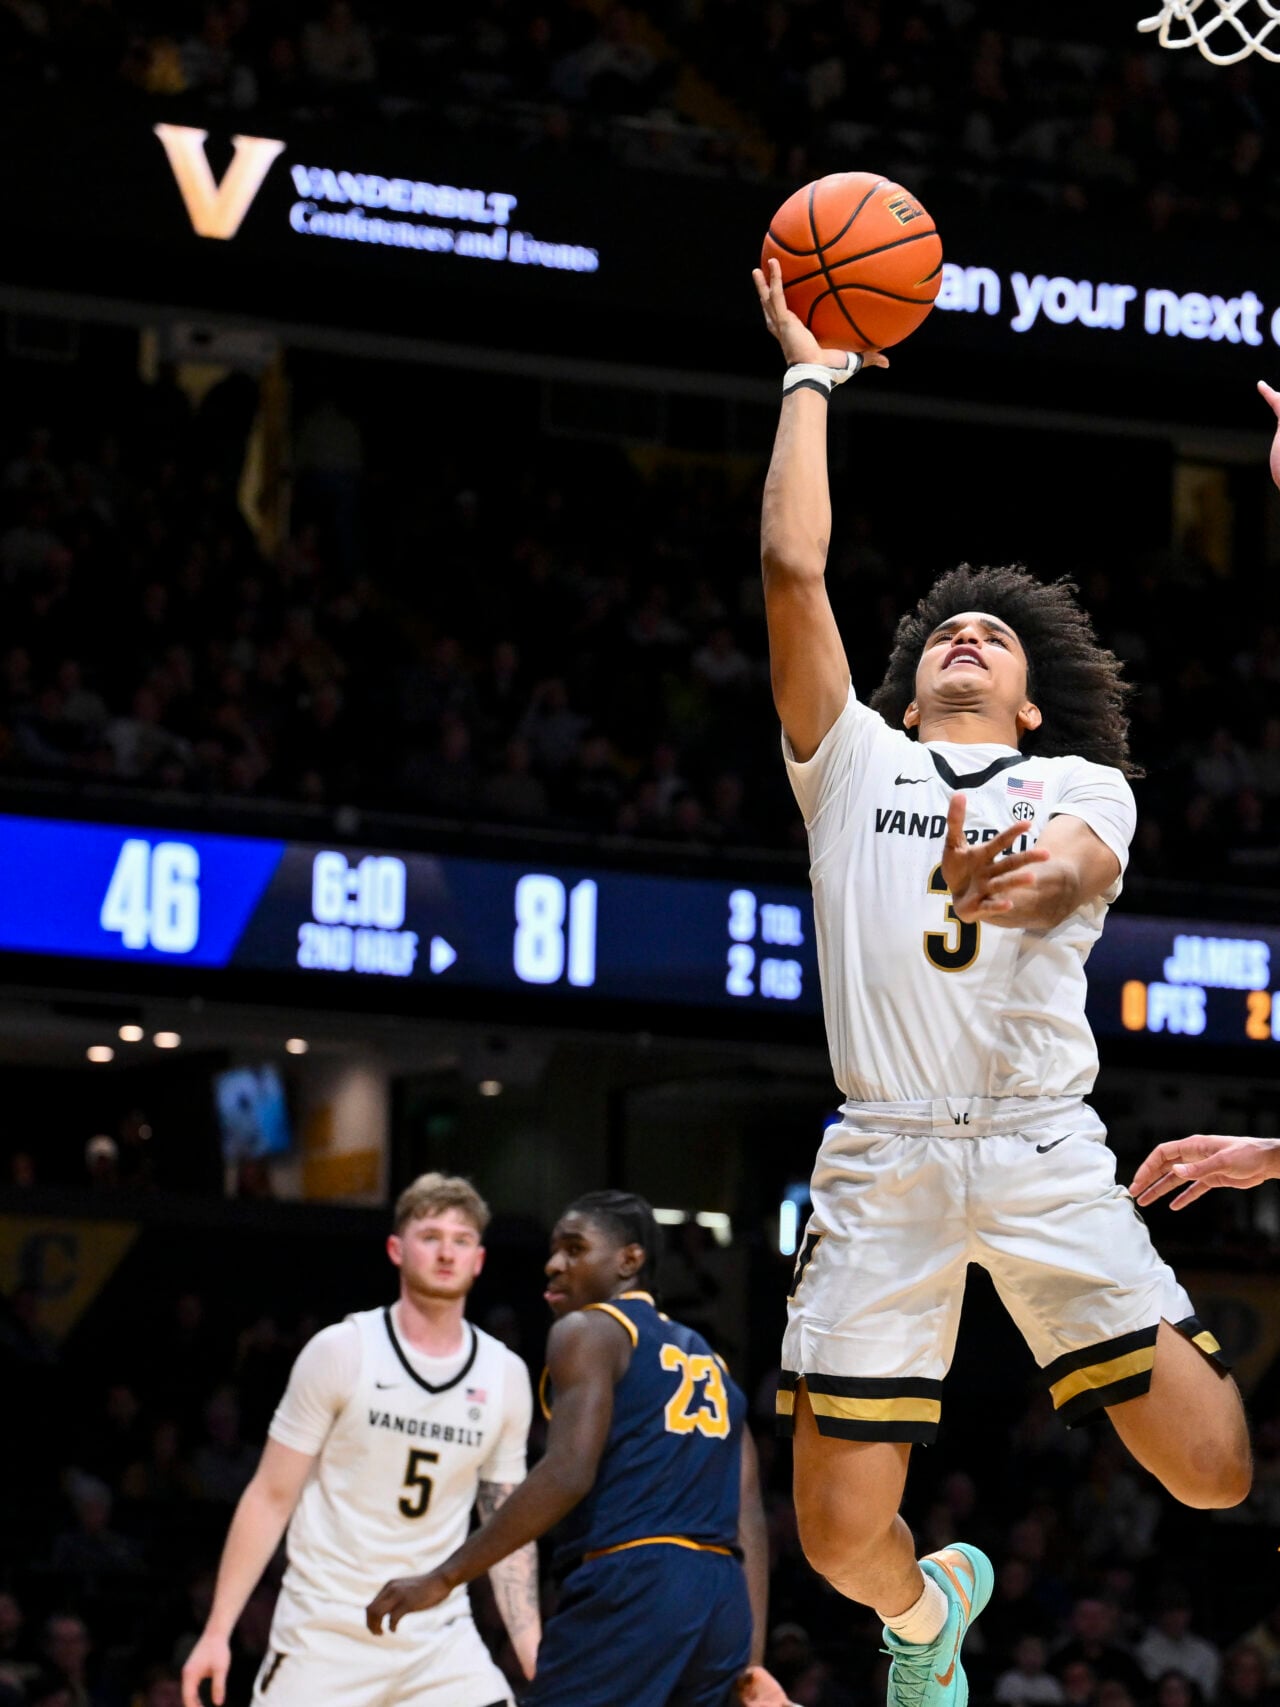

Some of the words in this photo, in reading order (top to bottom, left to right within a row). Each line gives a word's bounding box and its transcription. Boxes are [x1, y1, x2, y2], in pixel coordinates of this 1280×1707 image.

[154, 123, 286, 240] V
[290, 165, 518, 225] VANDERBILT
[290, 201, 454, 252] Conferences
[454, 226, 507, 260] and
[509, 231, 598, 272] Events
[1010, 272, 1138, 333] your
[1144, 288, 1264, 347] next
[100, 838, 201, 953] 46
[312, 850, 406, 930] 6:10
[728, 888, 757, 942] 3
[923, 863, 982, 973] 3
[297, 922, 353, 971] 2ND
[353, 926, 419, 977] HALF
[513, 873, 598, 987] 81
[1163, 934, 1270, 990] JAMES
[726, 943, 756, 996] 2
[1121, 979, 1147, 1031] 0
[1147, 981, 1207, 1035] PTS
[1245, 989, 1270, 1040] 2
[658, 1343, 731, 1440] 23
[367, 1408, 484, 1448] VANDERBILT
[399, 1447, 438, 1519] 5
